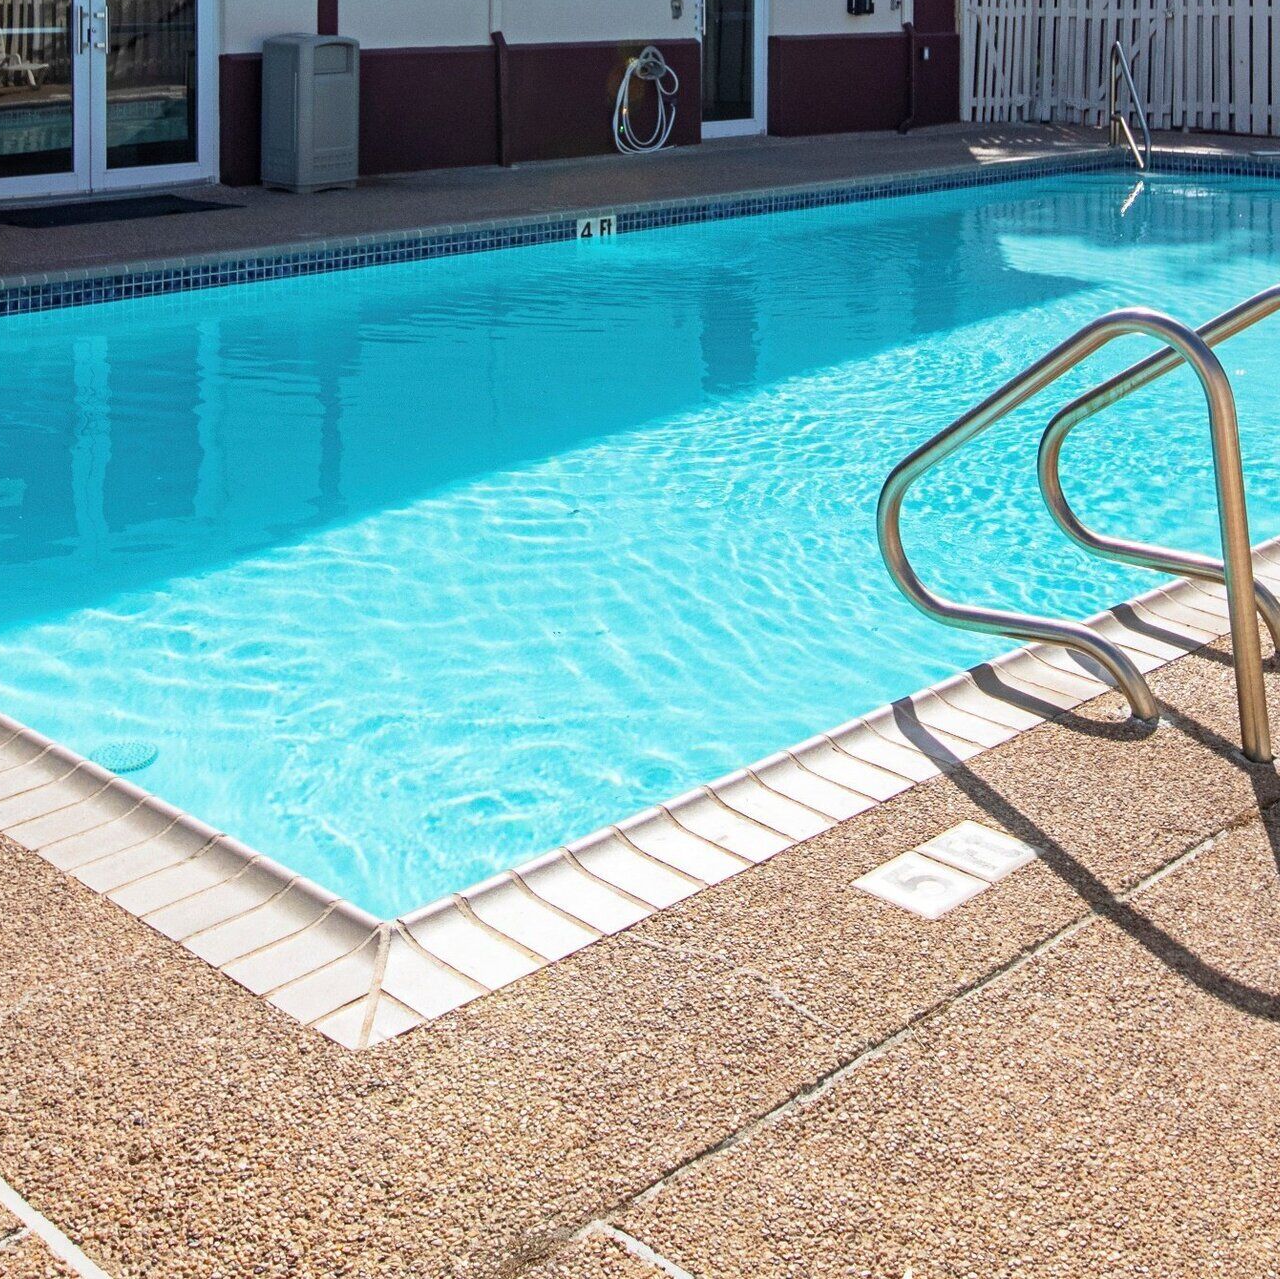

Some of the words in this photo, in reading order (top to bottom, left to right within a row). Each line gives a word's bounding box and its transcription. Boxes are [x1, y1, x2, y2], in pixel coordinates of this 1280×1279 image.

[580, 221, 593, 238] 4
[599, 218, 612, 237] Ft
[880, 863, 956, 896] 5
